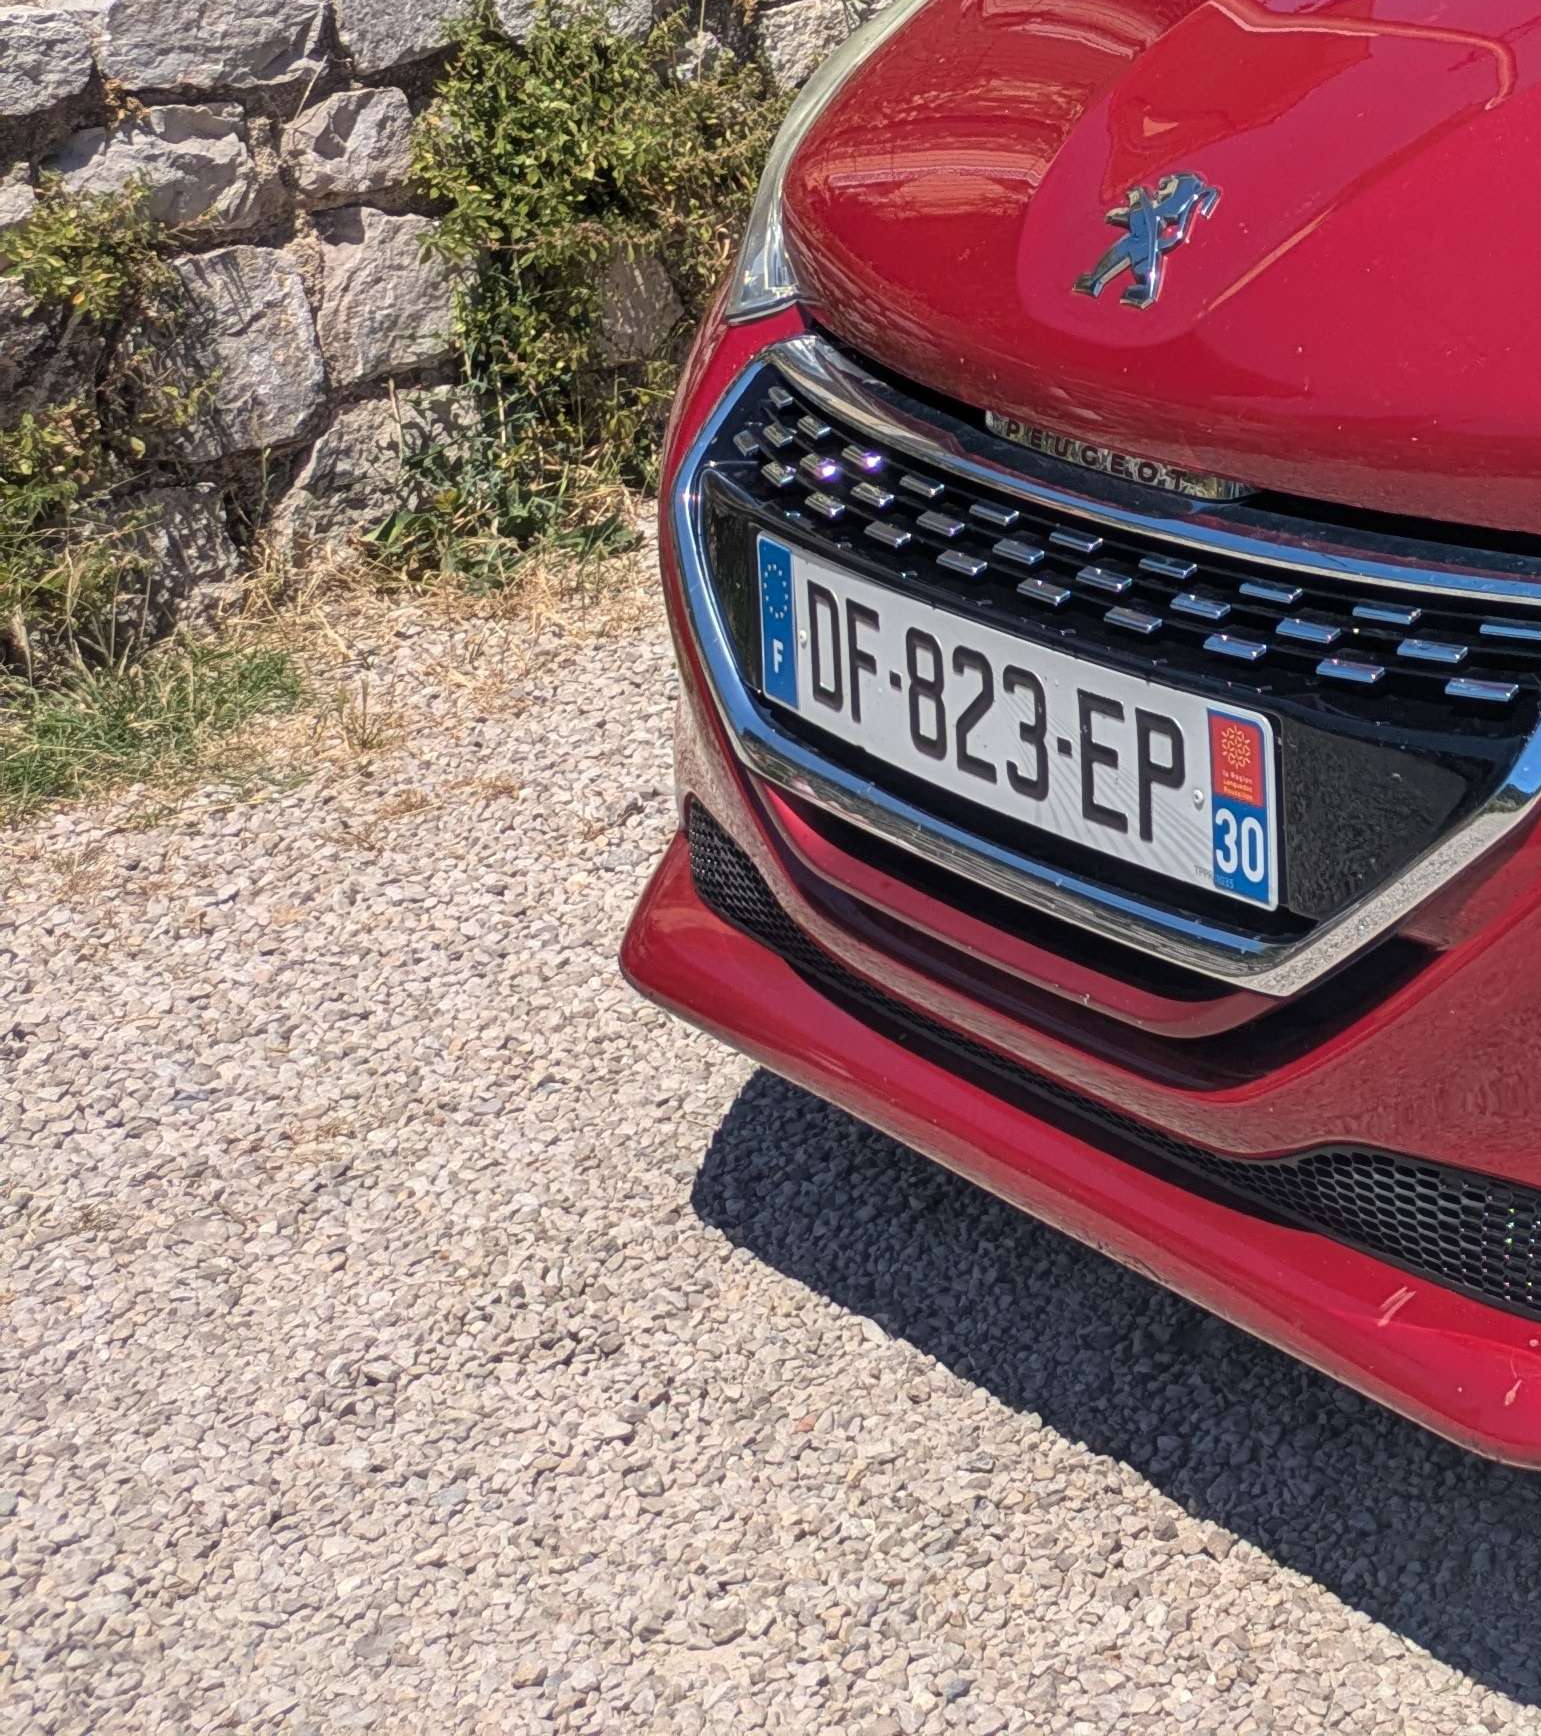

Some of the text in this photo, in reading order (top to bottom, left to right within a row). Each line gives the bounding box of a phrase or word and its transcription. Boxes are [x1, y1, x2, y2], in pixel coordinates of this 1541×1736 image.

[1006, 419, 1188, 490] PEUGEOT
[772, 638, 784, 674] F
[807, 579, 1186, 842] DF-823-EP
[1215, 807, 1265, 884] 30
